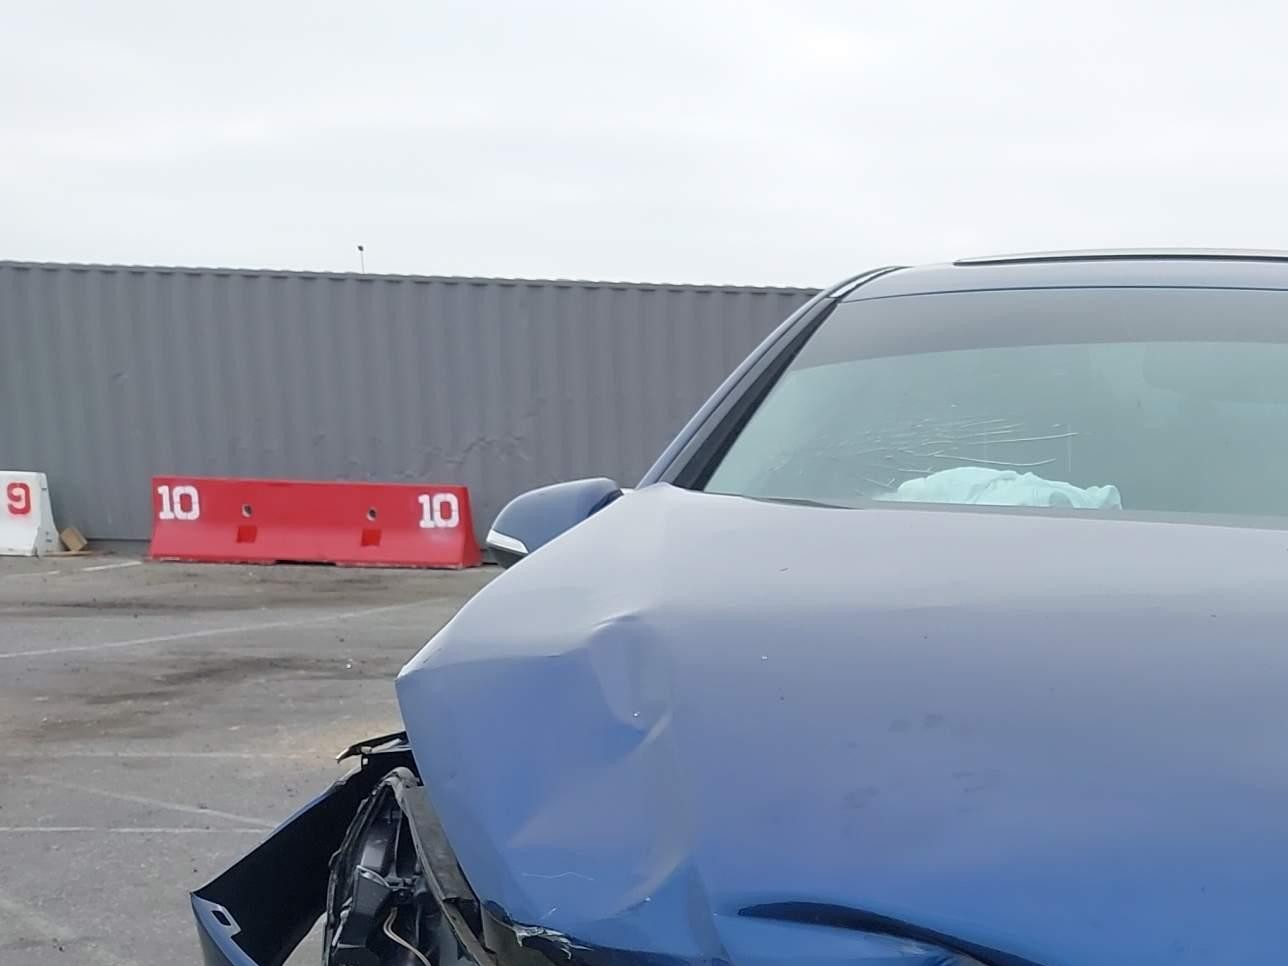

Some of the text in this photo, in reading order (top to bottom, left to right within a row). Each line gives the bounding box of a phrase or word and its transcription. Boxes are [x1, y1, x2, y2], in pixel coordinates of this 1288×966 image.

[6, 482, 31, 515] 9
[157, 485, 200, 520] 10
[418, 492, 460, 528] 10
